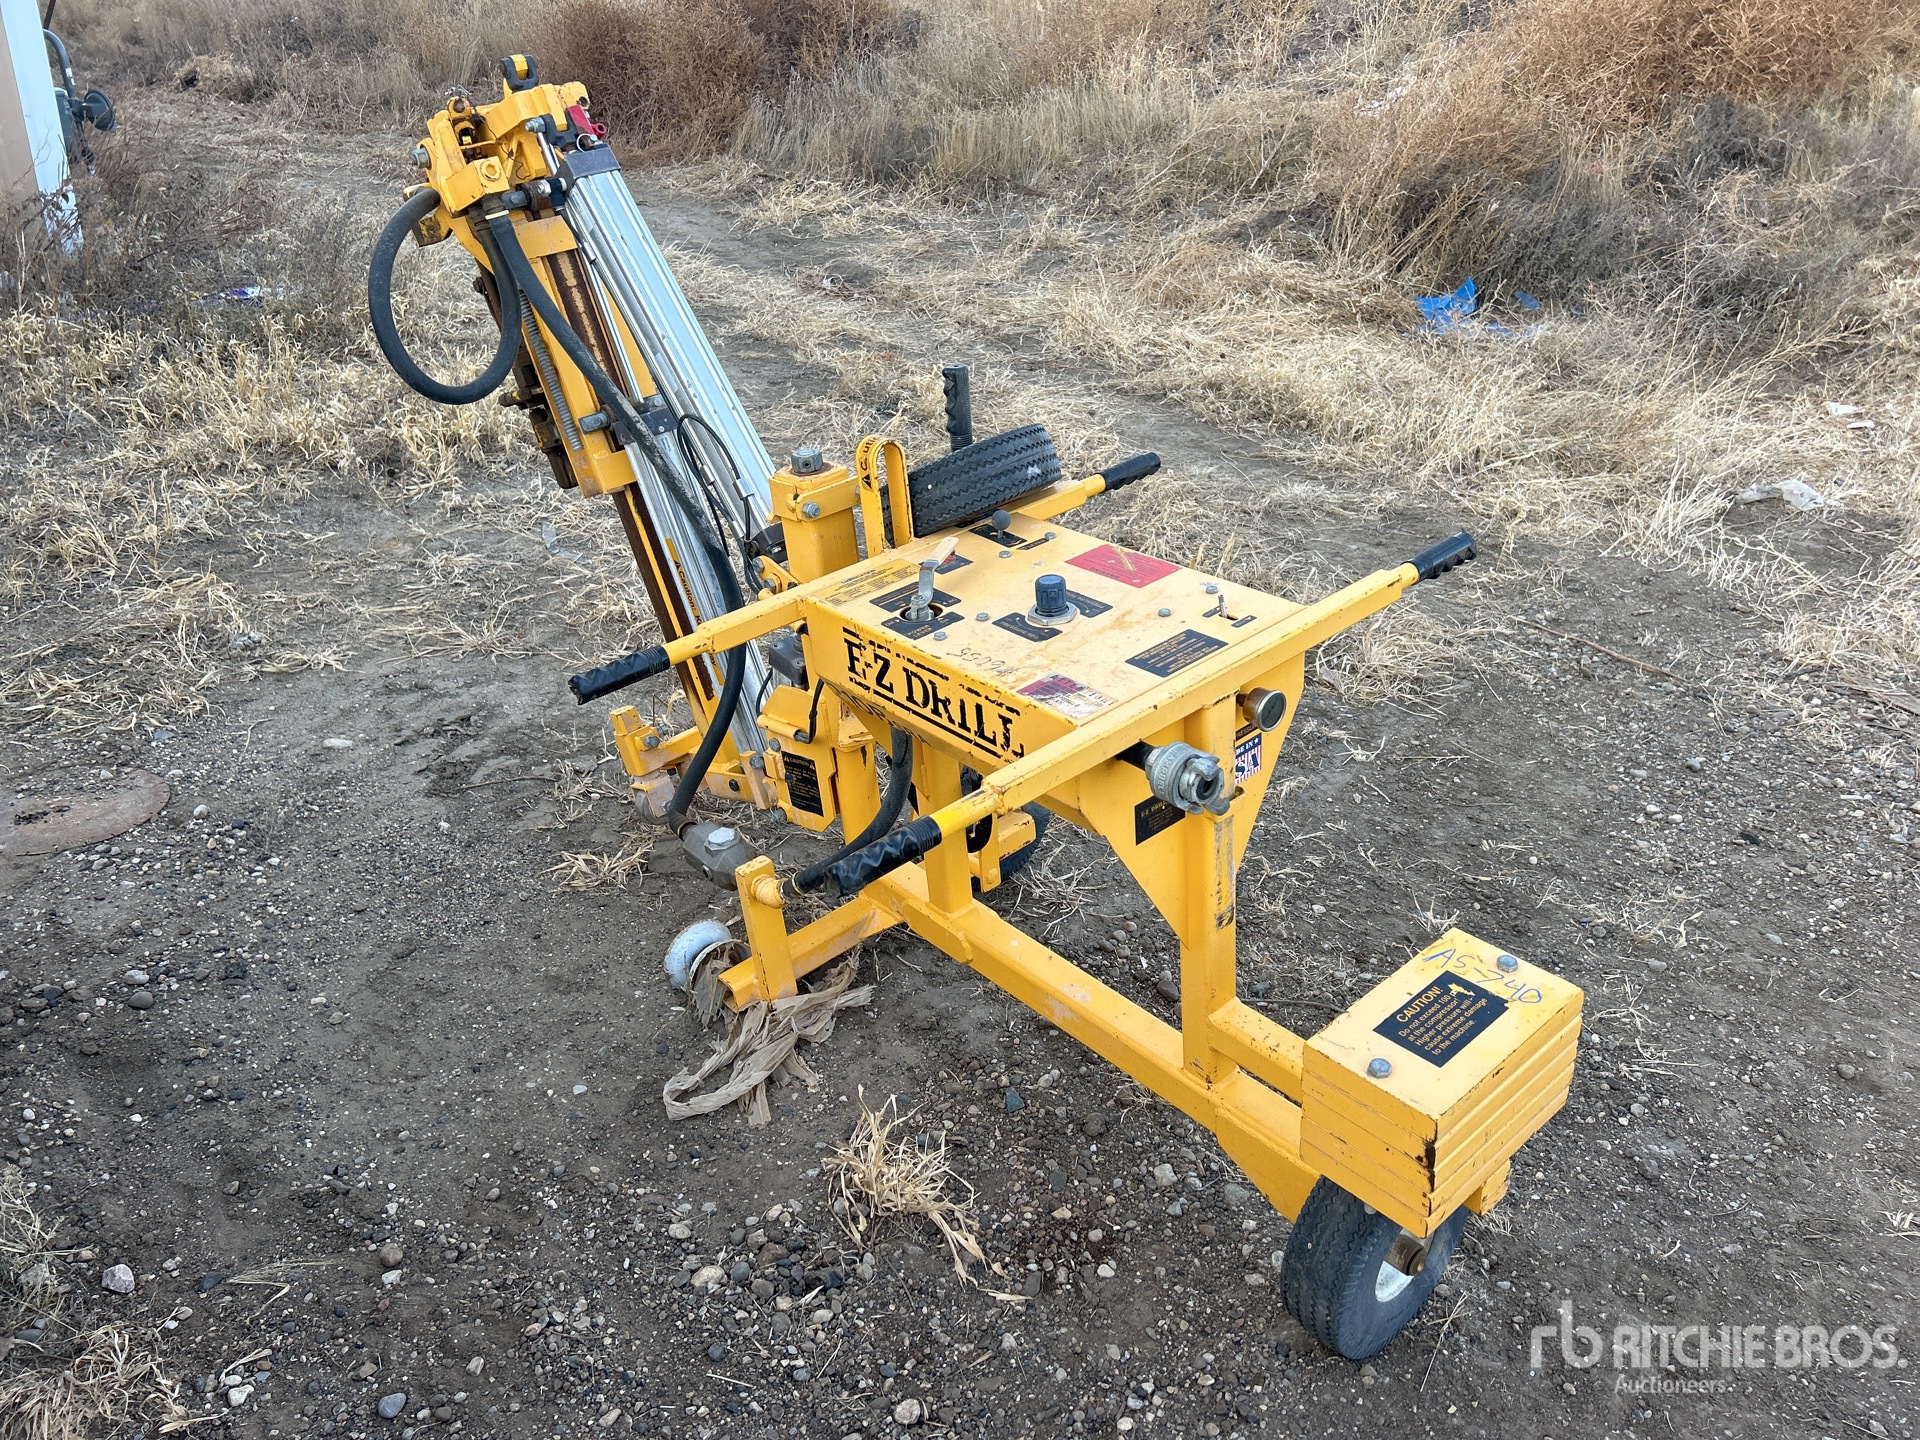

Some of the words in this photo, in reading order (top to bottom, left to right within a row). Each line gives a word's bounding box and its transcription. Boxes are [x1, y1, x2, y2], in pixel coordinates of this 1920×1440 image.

[902, 667, 1024, 758] DRILL
[1236, 746, 1245, 755] DE
[1236, 752, 1260, 779] SA
[1397, 985, 1443, 1022] CAUTION!
[1398, 1028, 1411, 1037] Do
[1409, 1019, 1420, 1031] not
[1420, 1004, 1441, 1021] exceed
[1408, 1034, 1414, 1042] at
[1414, 1026, 1426, 1037] the
[1415, 1028, 1437, 1046] Higher
[1435, 1008, 1462, 1031] pressure
[1459, 999, 1472, 1010] will
[1424, 1034, 1444, 1051] cause
[1442, 1016, 1465, 1037] extreme
[1464, 998, 1488, 1017] damage
[1432, 1047, 1441, 1055] to
[1439, 1039, 1452, 1050] the
[1450, 1019, 1477, 1042] machine.
